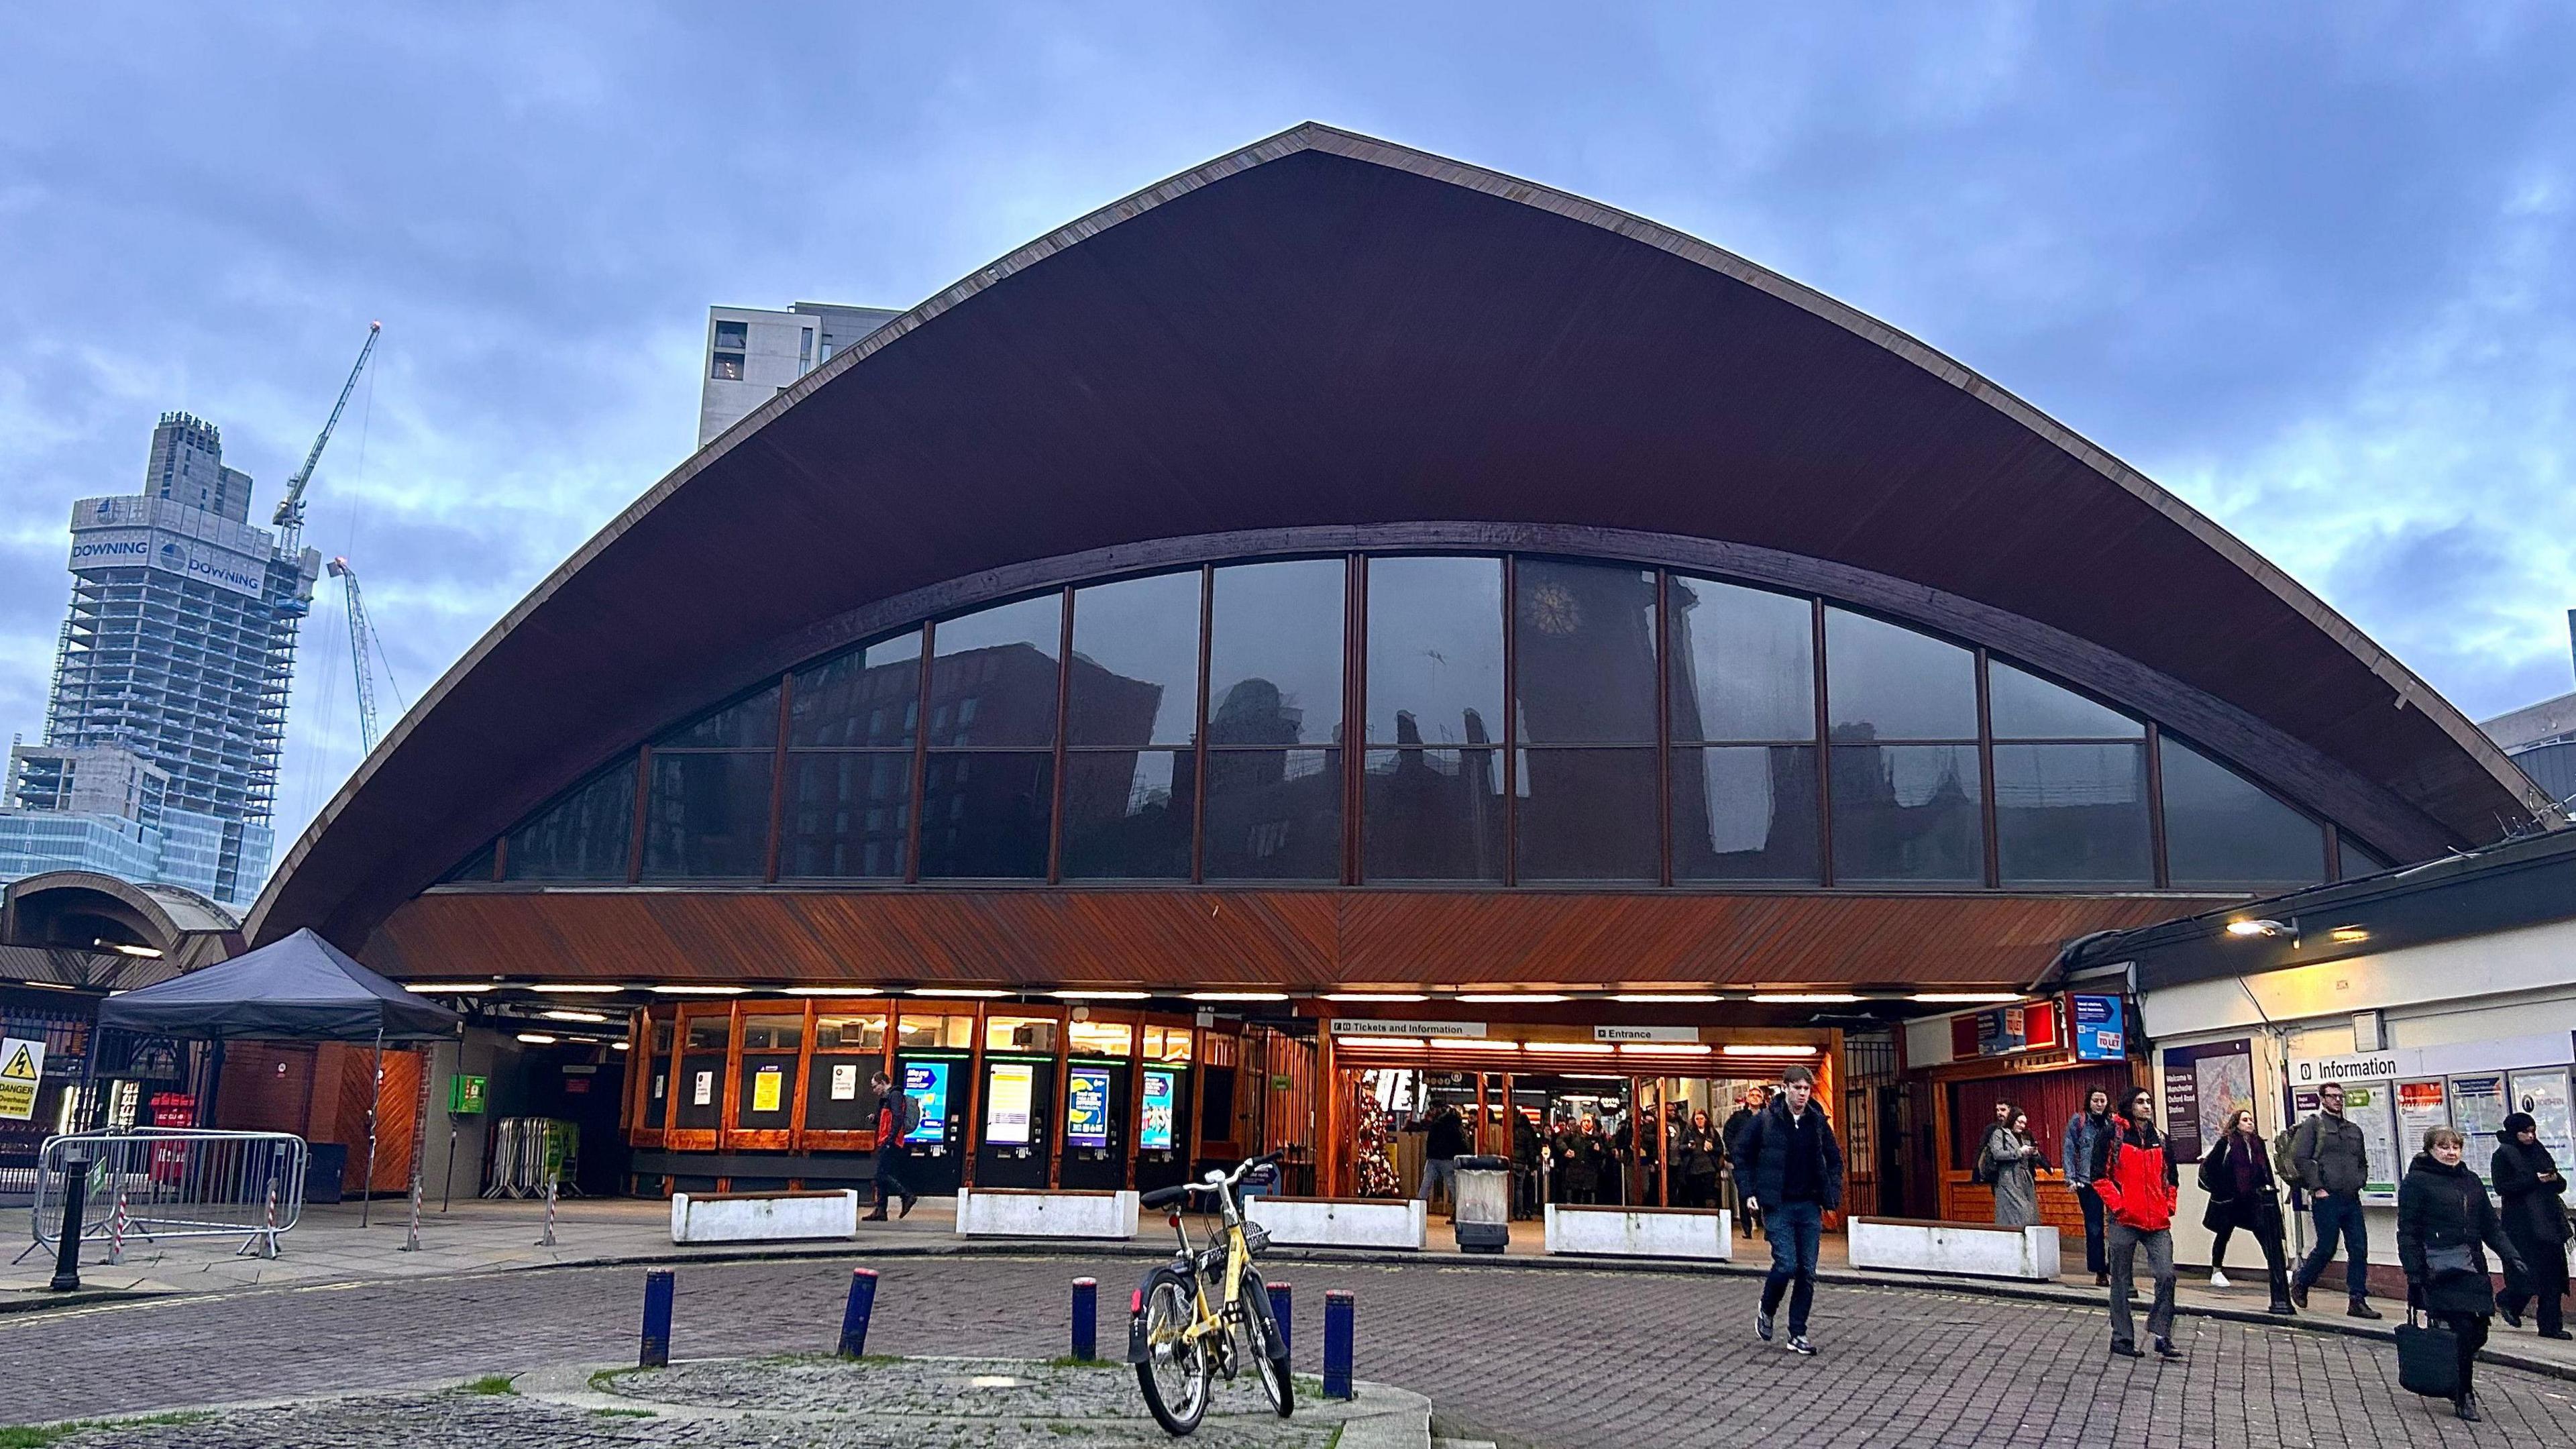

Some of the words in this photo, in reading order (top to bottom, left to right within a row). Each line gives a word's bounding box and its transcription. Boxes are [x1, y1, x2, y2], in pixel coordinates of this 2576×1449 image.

[72, 541, 148, 557] DOWNING
[188, 558, 259, 590] DOWNING
[1354, 1022, 1387, 1032] Tickets
[1389, 1024, 1406, 1032] and
[1409, 1024, 1462, 1034] Information
[1609, 1030, 1652, 1038] Entrance
[2099, 1038, 2108, 1046] TO
[2108, 1038, 2120, 1047] LET
[2318, 1057, 2397, 1079] Information
[0, 1083, 34, 1095] DANGER
[2167, 1084, 2193, 1093] Manchester
[2167, 1094, 2183, 1104] Oxford
[2184, 1093, 2196, 1102] Road
[2168, 1106, 2185, 1114] Station
